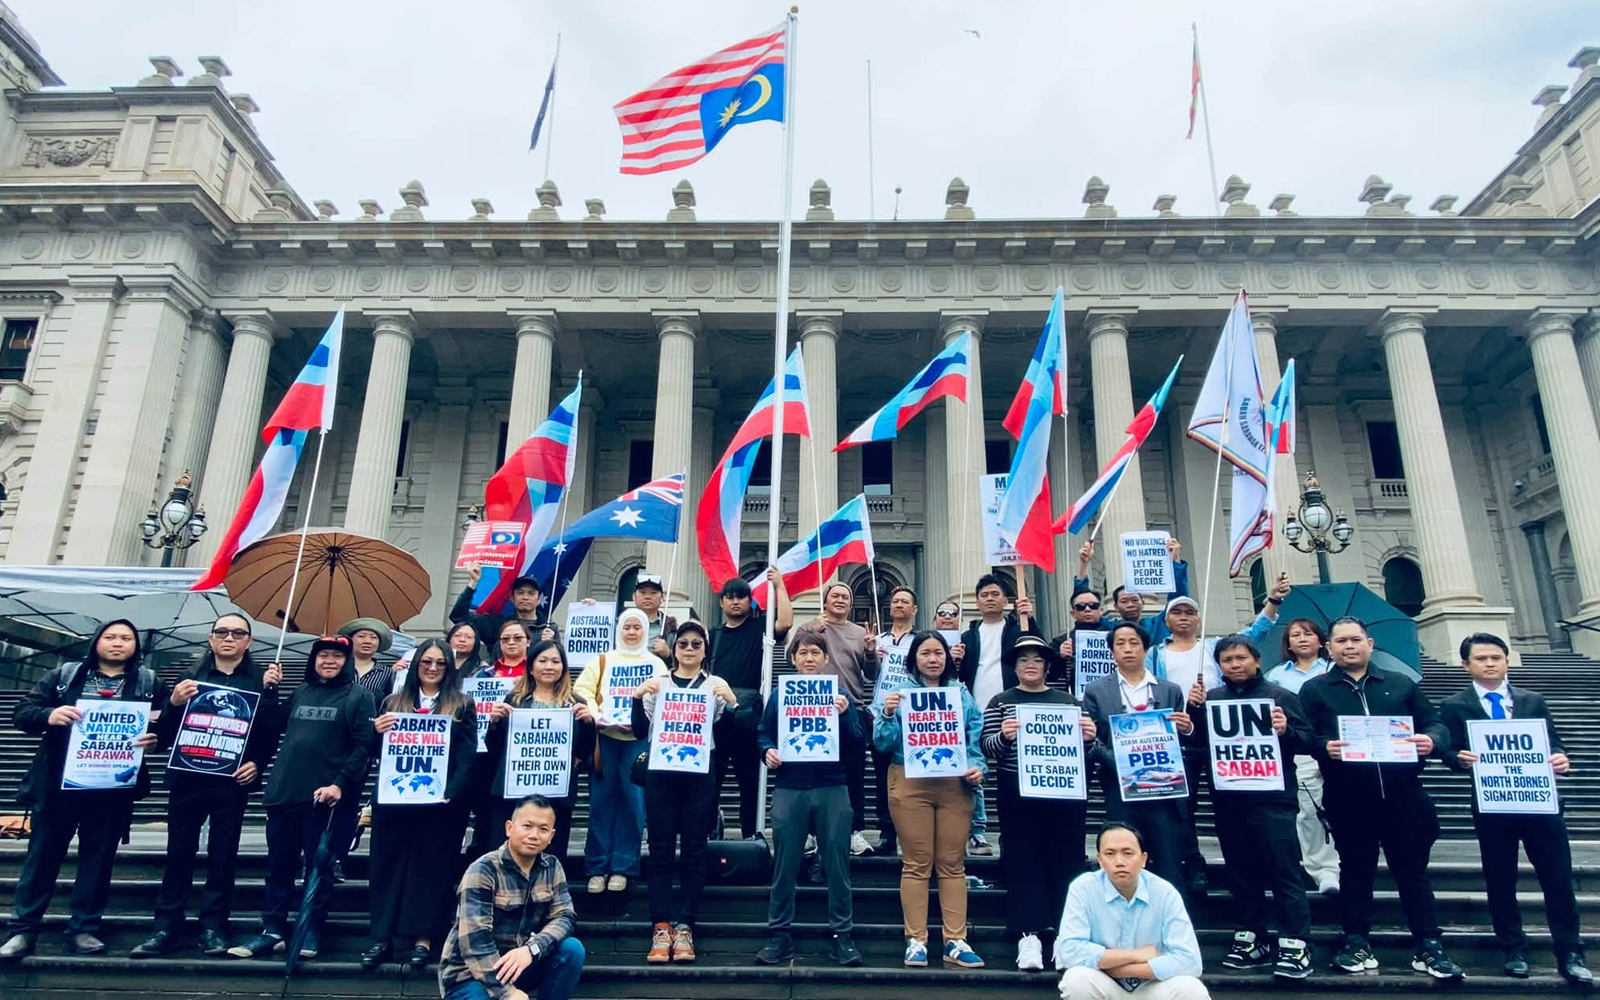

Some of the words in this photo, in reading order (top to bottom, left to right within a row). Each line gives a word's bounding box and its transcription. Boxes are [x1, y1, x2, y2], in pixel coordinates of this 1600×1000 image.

[1127, 549, 1137, 557] NO
[1132, 560, 1146, 568] LET
[1148, 560, 1163, 568] THE
[570, 627, 597, 638] LISTEN
[598, 628, 608, 638] TO
[568, 639, 610, 653] BORNEO
[1087, 639, 1106, 648] NOR
[612, 664, 654, 677] UNITED
[1081, 661, 1116, 674] HISTOR
[477, 681, 504, 690] SELF-
[785, 680, 833, 695] SSKM
[665, 692, 685, 702] LET
[687, 693, 707, 703] THE
[783, 695, 834, 706] AUSTRALIA
[910, 692, 952, 711] UN,
[664, 702, 706, 713] UNITED
[785, 706, 816, 716] AKAN
[819, 706, 832, 716] KE
[89, 712, 136, 724] UNITED
[661, 711, 707, 723] NATIONS
[908, 712, 936, 722] HEAR
[938, 711, 957, 721] THE
[1035, 714, 1063, 722] FROM
[1211, 703, 1273, 738] UN
[86, 723, 137, 734] NATIONS
[210, 715, 249, 734] BORNEO
[392, 718, 447, 732] SABAH'S
[531, 718, 552, 729] LET
[664, 721, 702, 734] HEAR
[789, 717, 832, 732] PBB.
[908, 722, 942, 732] VOICE
[944, 722, 958, 732] OF
[1025, 723, 1073, 735] COLONY
[178, 730, 211, 748] UNITED
[209, 734, 245, 754] NATIONS
[389, 732, 419, 744] CASE
[421, 733, 446, 745] WILL
[513, 731, 568, 745] SABAHANS
[658, 732, 706, 746] SABAH.
[908, 732, 962, 746] SABAH.
[1043, 736, 1056, 744] TO
[1140, 735, 1174, 744] AUSTRALIA
[1484, 734, 1533, 751] WHO
[80, 740, 124, 750] SABAH
[125, 741, 133, 750] &
[388, 745, 424, 756] REACH
[427, 745, 444, 756] THE
[1024, 745, 1077, 757] FREEDOM
[1131, 744, 1153, 752] AKAN
[76, 750, 135, 760] SARAWAK
[521, 747, 558, 757] DECIDE
[1215, 744, 1275, 760] HEAR
[396, 756, 437, 773] UN.
[1128, 751, 1175, 767] PBB.
[1480, 753, 1544, 764] AUTHORISED
[511, 760, 540, 771] THEIR
[543, 760, 566, 771] OWN
[1025, 764, 1043, 774] LET
[1045, 765, 1078, 775] SABAH
[1217, 761, 1278, 776] SABAH
[1504, 766, 1523, 774] THE
[516, 773, 559, 786] FUTURE
[1030, 775, 1075, 788] DECIDE
[1480, 776, 1512, 788] NORTH
[1514, 776, 1550, 788] BORNEO
[1483, 790, 1551, 802] SIGNATORIES?
